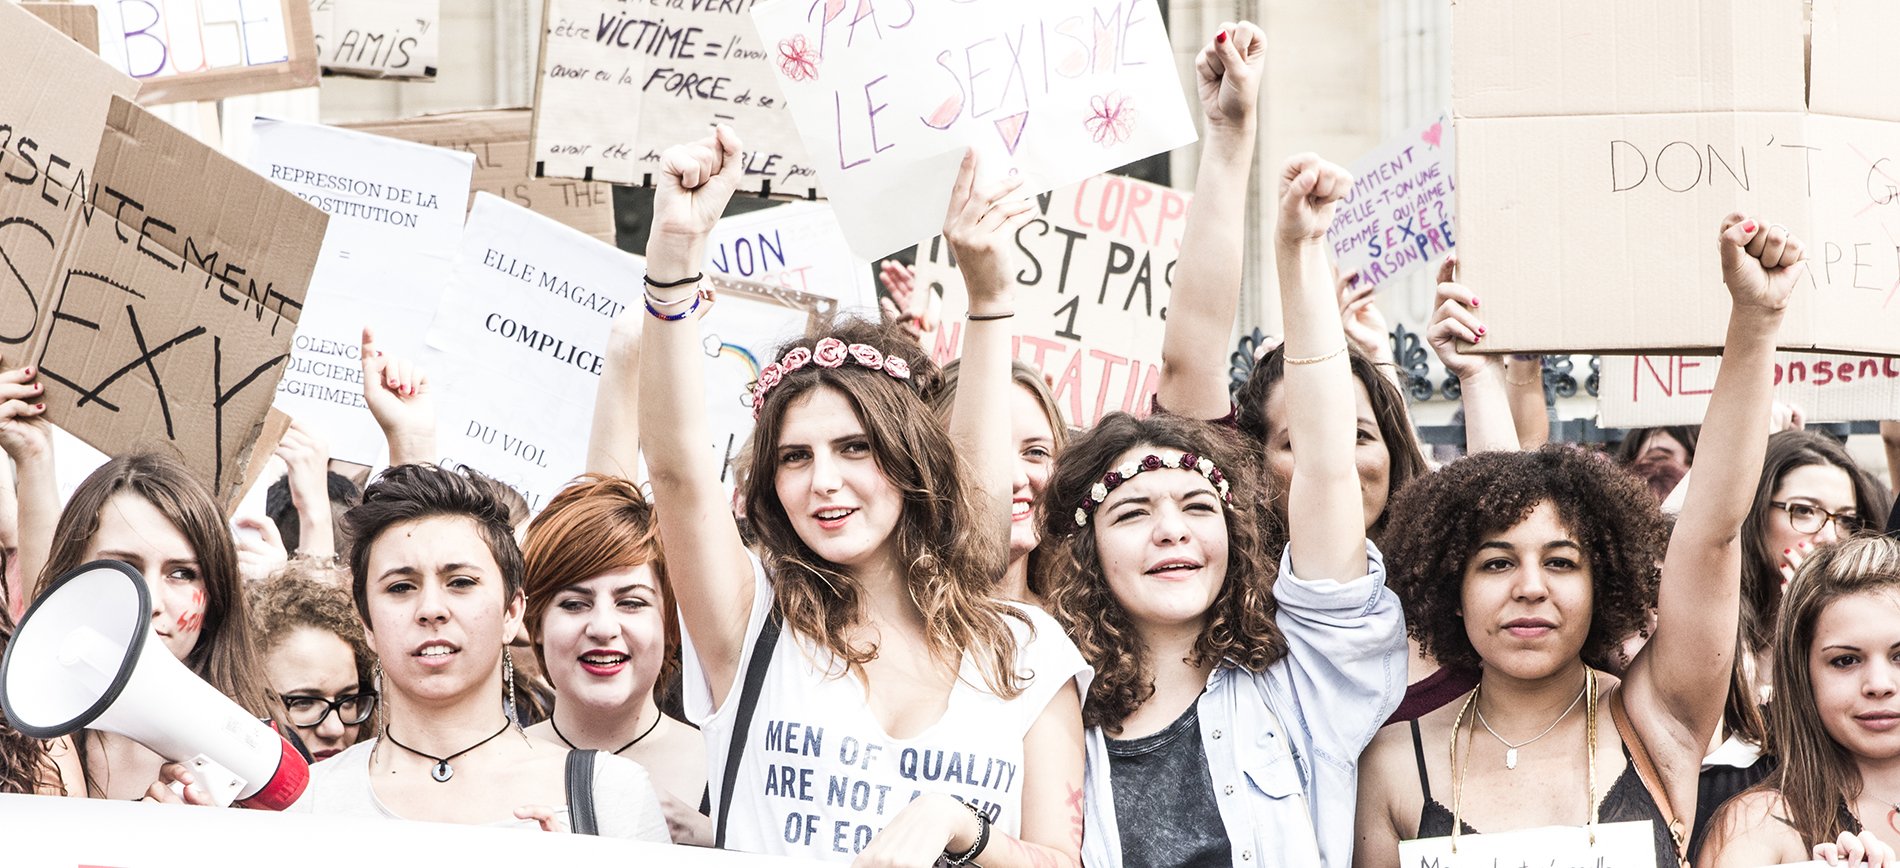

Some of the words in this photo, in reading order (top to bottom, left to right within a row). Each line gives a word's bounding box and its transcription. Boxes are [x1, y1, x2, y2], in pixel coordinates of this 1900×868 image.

[551, 63, 591, 80] avoir
[643, 67, 732, 102] FORCE
[836, 75, 895, 170] LE
[920, 0, 1148, 131] SEXISME
[270, 163, 382, 198] REPRESSION
[386, 186, 413, 204] DE
[415, 192, 439, 210] LA
[1335, 146, 1414, 213] OMMENT
[1415, 162, 1440, 188] UNE
[1610, 133, 1822, 198] DON'T
[549, 182, 606, 208] THE
[1334, 219, 1381, 258] FEMME
[1368, 207, 1431, 258] SEXE
[483, 249, 535, 283] ELLE
[1053, 295, 1081, 342] 1
[0, 217, 291, 497] SEXY
[465, 420, 498, 445] DU
[503, 434, 547, 468] VIOL
[765, 720, 824, 758] MEN
[839, 736, 883, 771] OF
[899, 747, 1017, 793] QUALITY
[765, 764, 815, 802] ARE
[827, 775, 892, 816] NOT
[784, 812, 821, 846] OF
